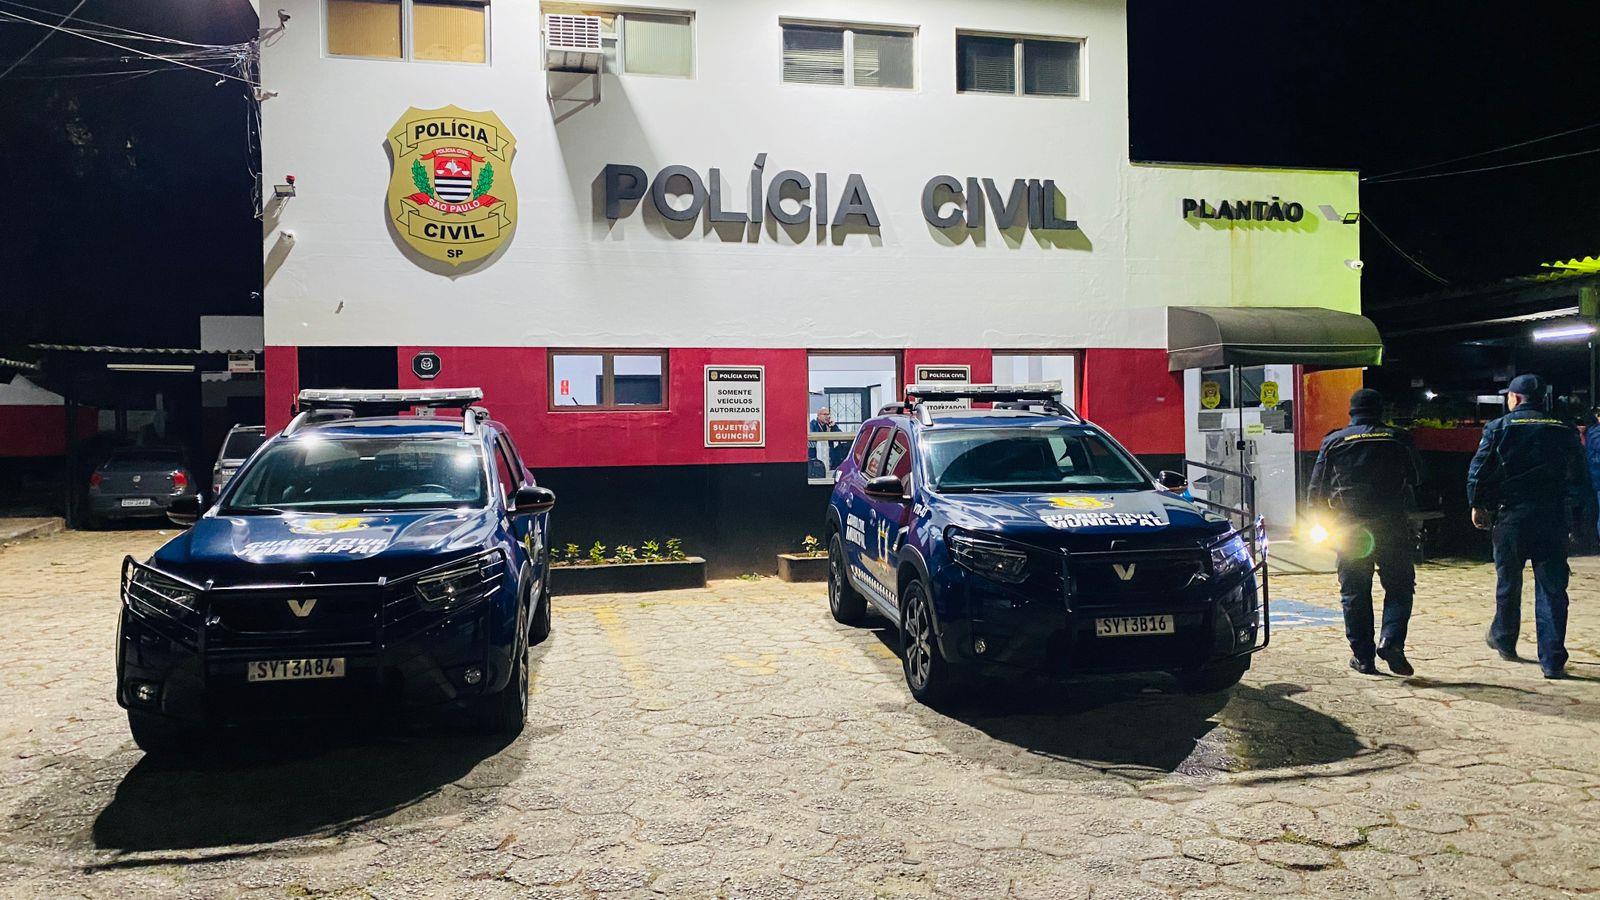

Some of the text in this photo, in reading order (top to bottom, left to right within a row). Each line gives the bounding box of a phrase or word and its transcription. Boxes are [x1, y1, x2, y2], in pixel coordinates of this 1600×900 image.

[415, 119, 488, 143] POLÍCIA
[605, 153, 1077, 230] POLÍCIA CIVIL
[450, 200, 480, 212] PAULO
[1182, 196, 1304, 222] PLANTÃO
[424, 223, 485, 240] CIVIL
[447, 249, 464, 258] SP
[1047, 517, 1170, 529] MUNICIPAL
[1104, 616, 1166, 633] SYT3B16
[257, 658, 335, 678] SYT3A84
